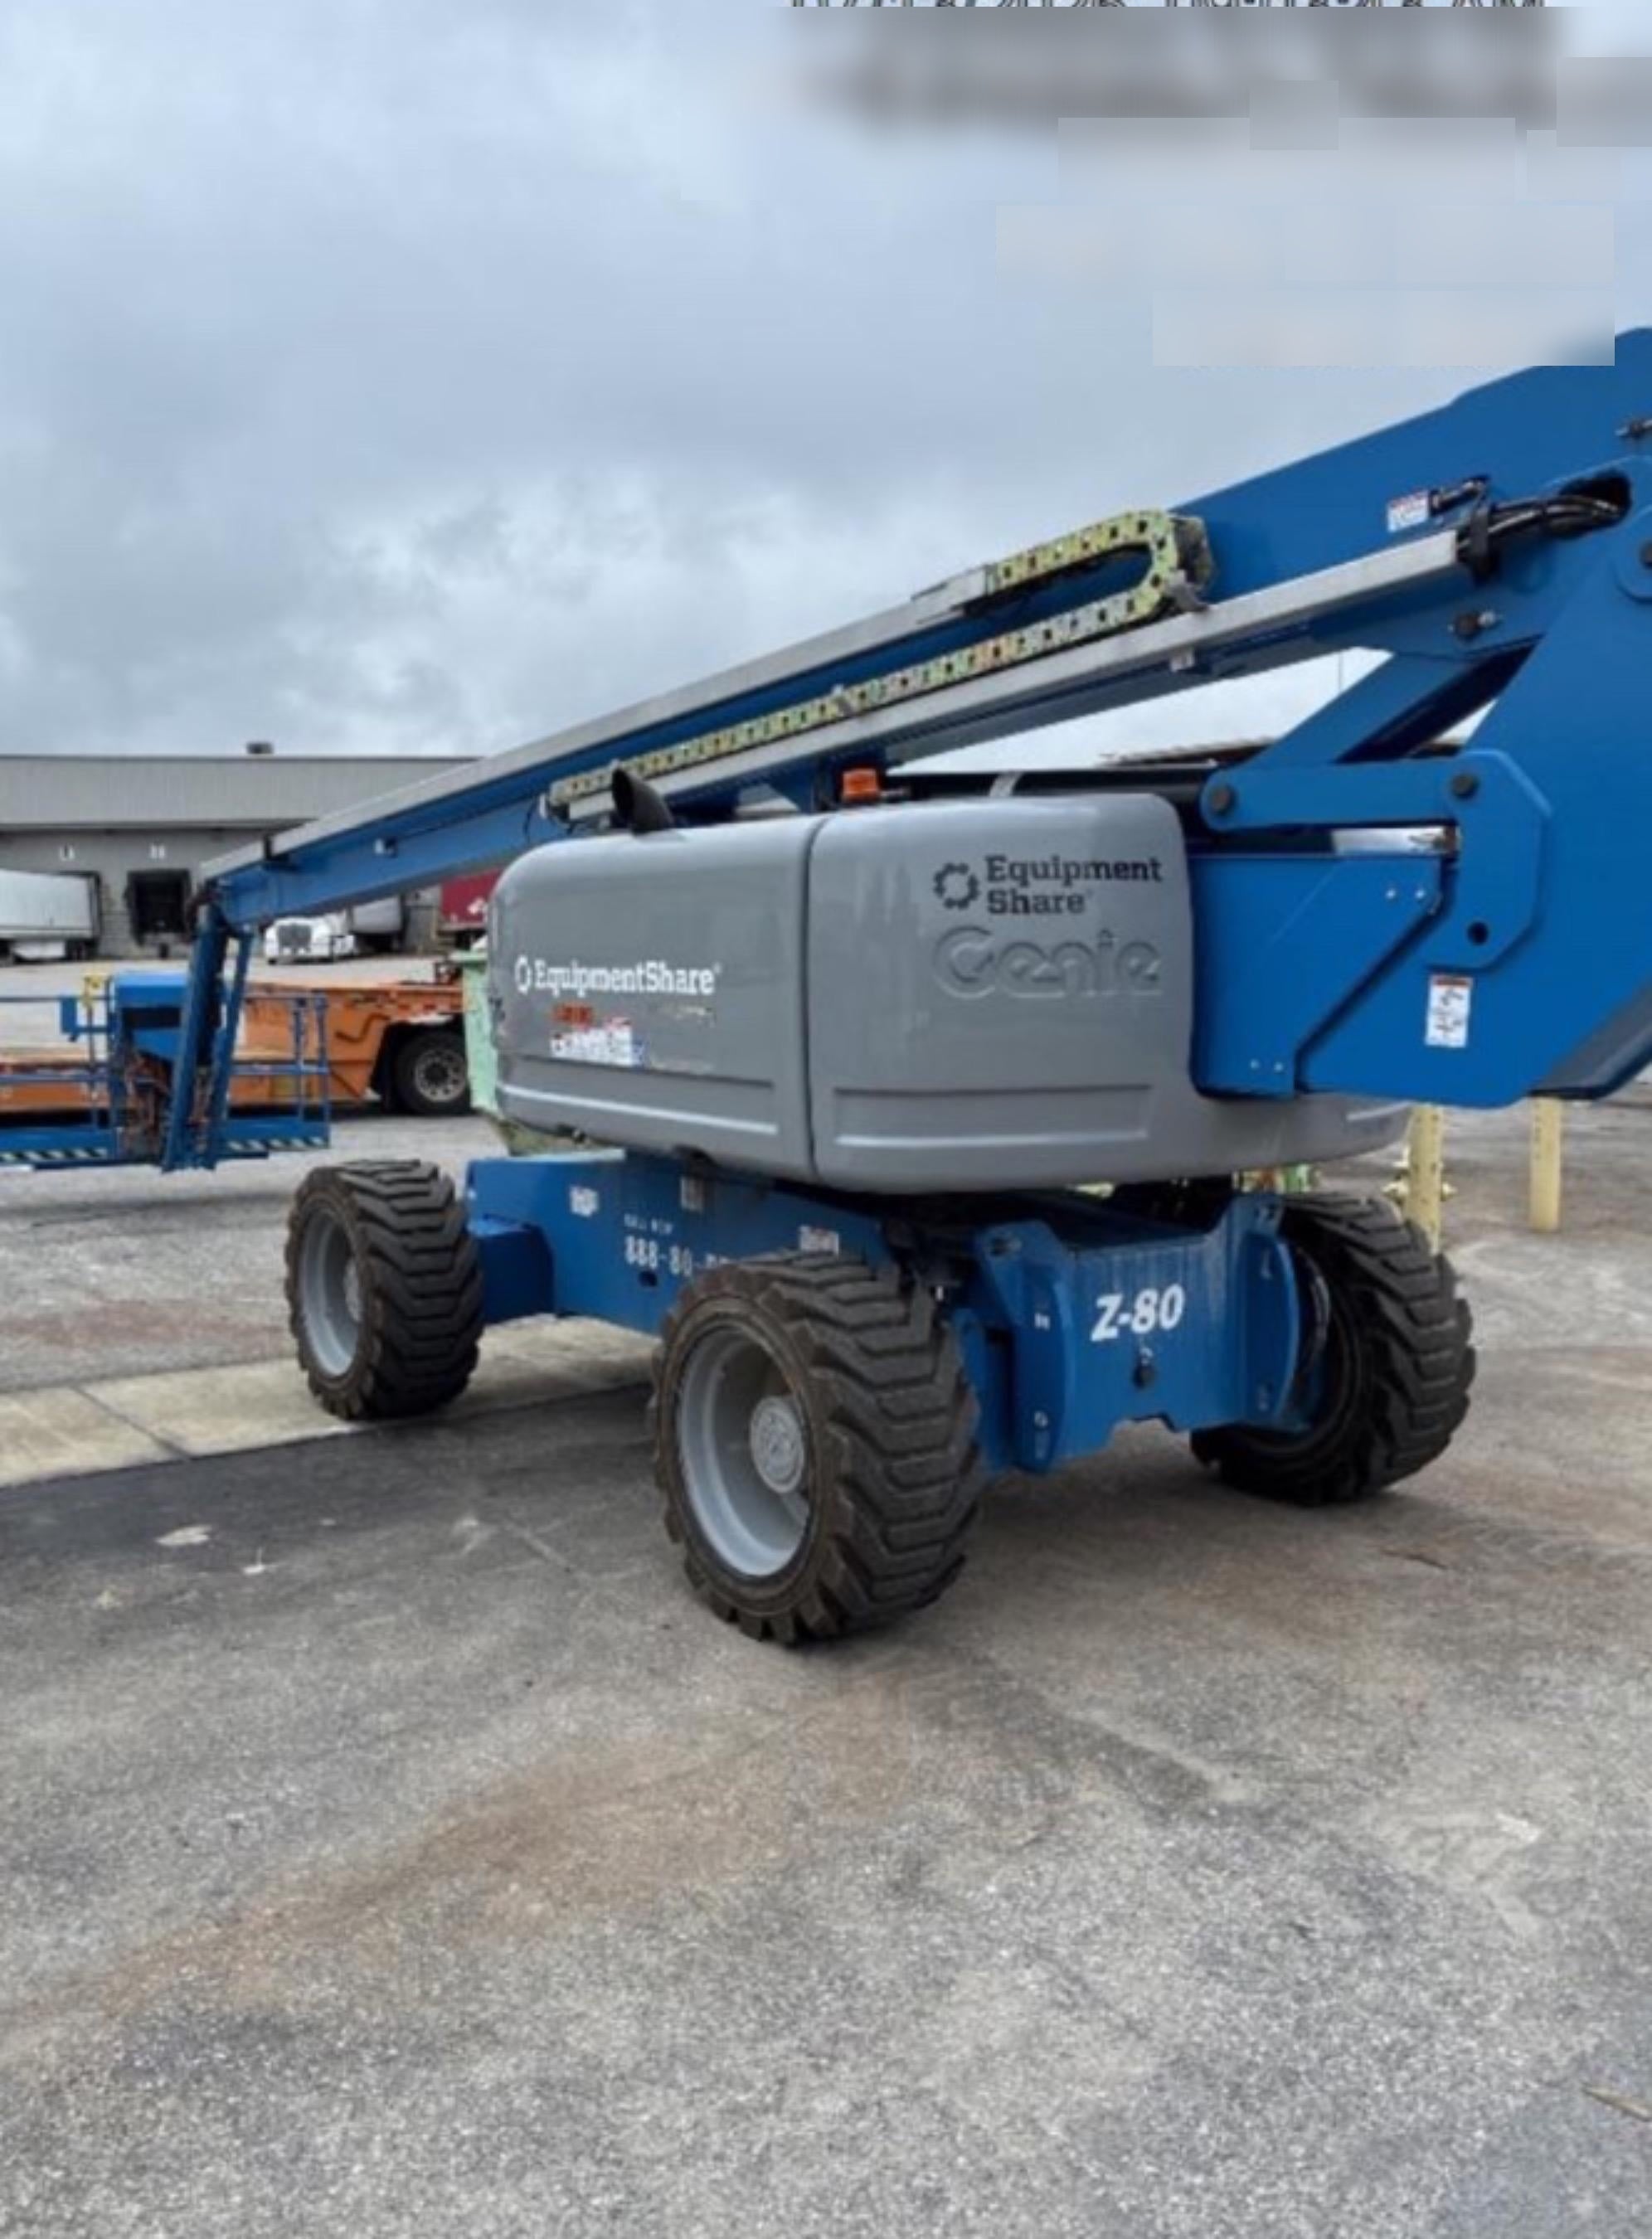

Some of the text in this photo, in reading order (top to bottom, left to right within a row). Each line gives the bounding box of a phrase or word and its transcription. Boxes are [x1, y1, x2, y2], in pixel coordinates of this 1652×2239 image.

[984, 855, 1163, 886] Equipment
[986, 889, 1085, 915] Share
[1091, 1284, 1185, 1341] Z-80
